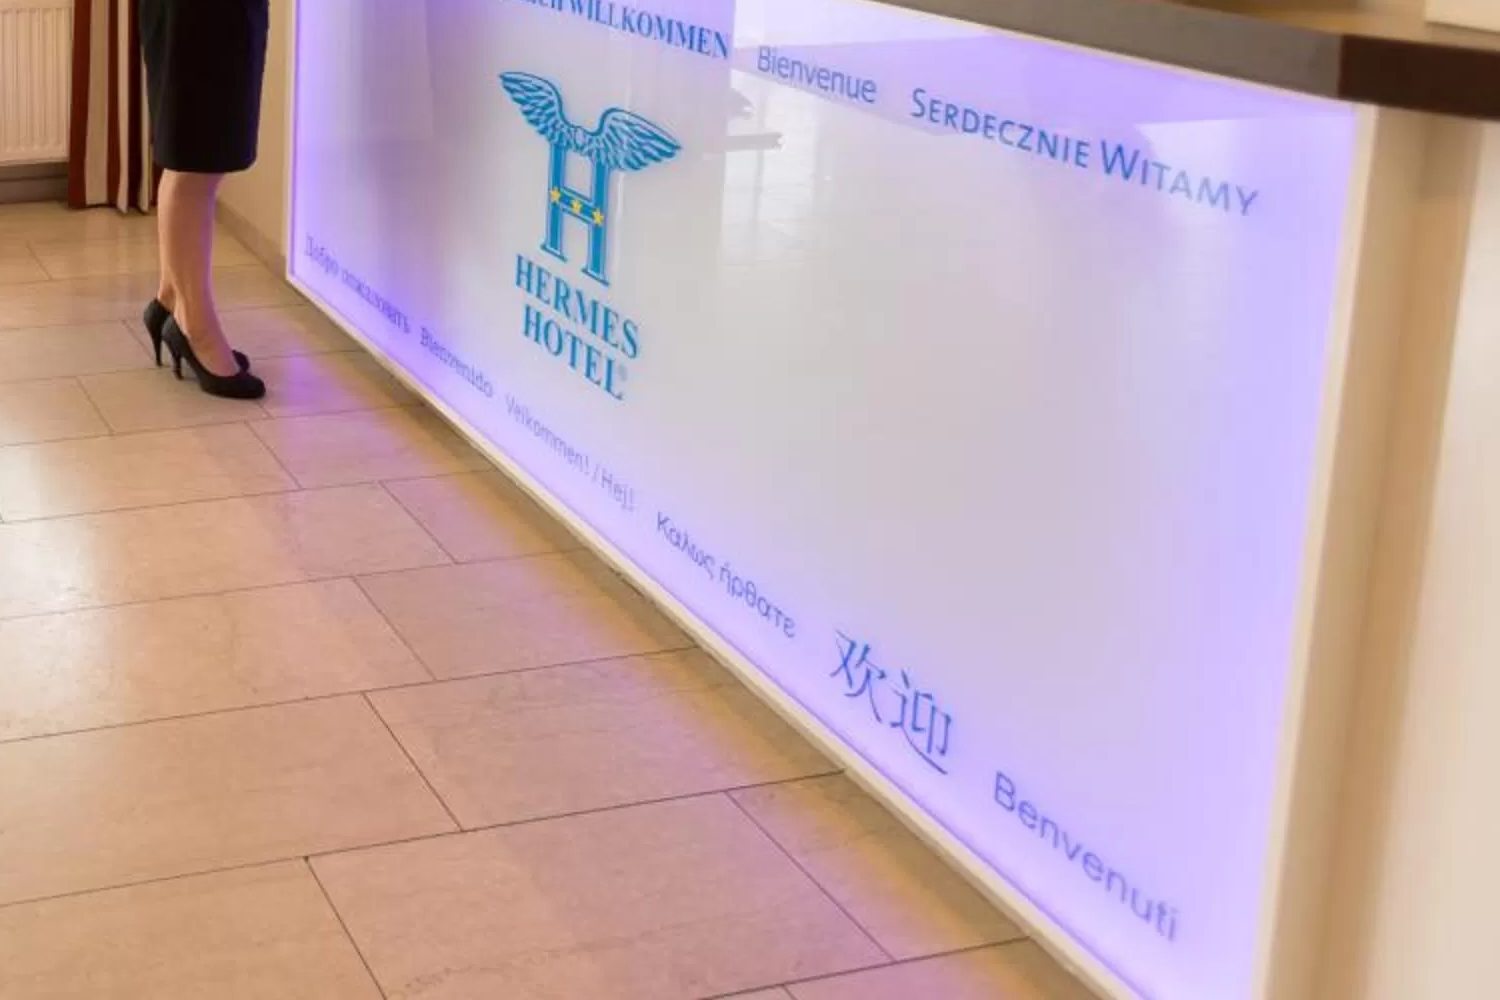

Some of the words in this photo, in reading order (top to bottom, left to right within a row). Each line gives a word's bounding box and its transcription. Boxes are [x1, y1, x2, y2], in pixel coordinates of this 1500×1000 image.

[756, 45, 878, 104] Bienvenue
[911, 88, 1090, 169] SERDECZNIE
[1101, 140, 1260, 217] WITAMY
[515, 253, 639, 359] HERMES
[829, 628, 952, 776] 欢迎
[993, 769, 1180, 942] Benvenuti
